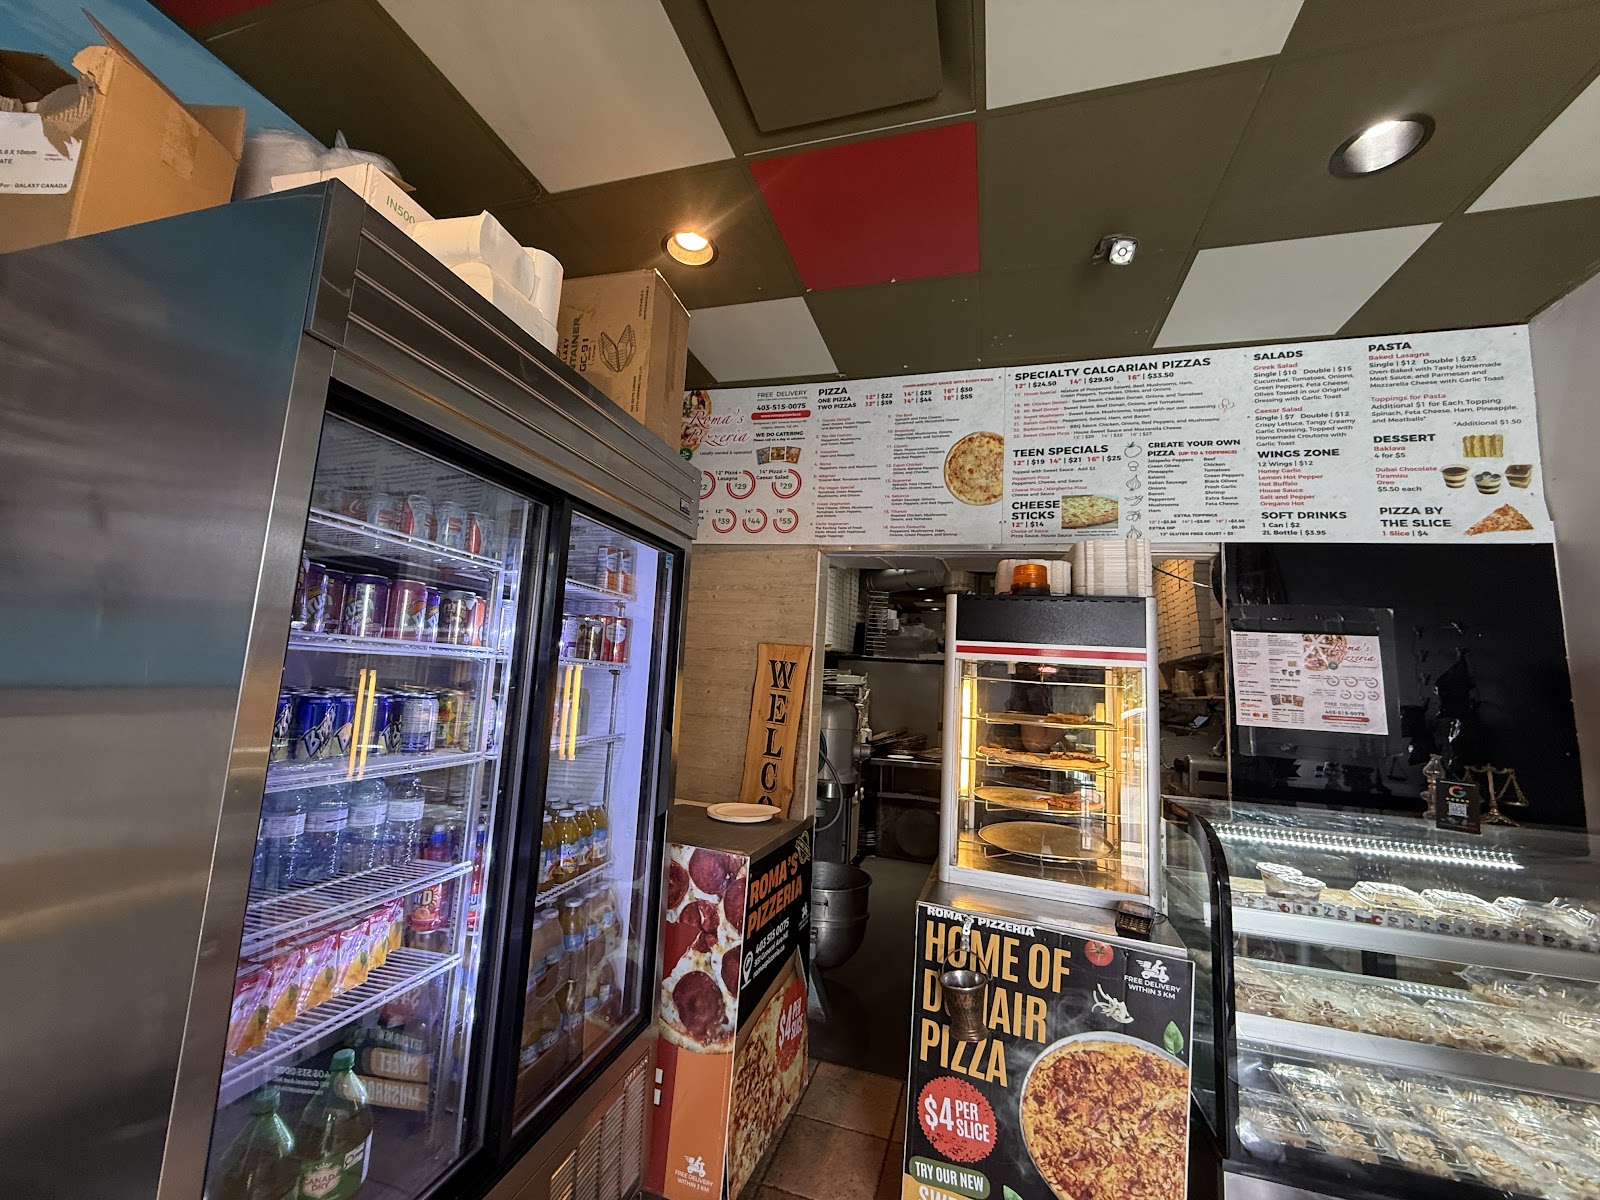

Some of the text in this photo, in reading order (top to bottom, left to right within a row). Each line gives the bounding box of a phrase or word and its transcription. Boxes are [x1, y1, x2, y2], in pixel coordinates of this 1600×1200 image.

[1253, 350, 1303, 360] SALADS
[1368, 342, 1412, 352] PASTA
[1423, 357, 1454, 365] Double
[1461, 355, 1477, 363] $23
[1014, 357, 1211, 381] SPECIALTY CALGARIAN PIZZAS
[1032, 380, 1057, 389] $24.50
[1088, 376, 1114, 384] $29.50
[1147, 372, 1175, 380] $33.50
[818, 387, 848, 396] PIZZA
[1371, 402, 1413, 410] Additional
[689, 408, 744, 429] Roma's
[686, 429, 750, 447] Pizzeria
[1373, 434, 1436, 443] DESSERT
[1013, 444, 1109, 457] TEEN SPECIALS
[1257, 449, 1340, 458] WINGS ZONE
[1012, 500, 1060, 510] CHEESE
[1380, 507, 1443, 515] PIZZA BY
[1011, 511, 1055, 520] STICKS
[1380, 519, 1452, 527] THE SLICE
[749, 852, 799, 908] ROMA'S
[746, 874, 803, 940] PIZZERIA
[977, 917, 1036, 937] PIZZERIA
[925, 920, 1072, 993] HOME OF
[1124, 974, 1181, 993] FREE DELIVERY
[1128, 983, 1156, 995] WITHIN
[1163, 991, 1176, 999] KM
[923, 968, 1047, 1044] DAIR
[779, 1004, 792, 1051] $4
[920, 1018, 1008, 1088] PIZZA
[924, 1094, 979, 1131] $4 PER
[956, 1119, 990, 1142] SLICE
[675, 1170, 713, 1186] FREE DELIVERY
[915, 1161, 984, 1192] TRY OUR NEW
